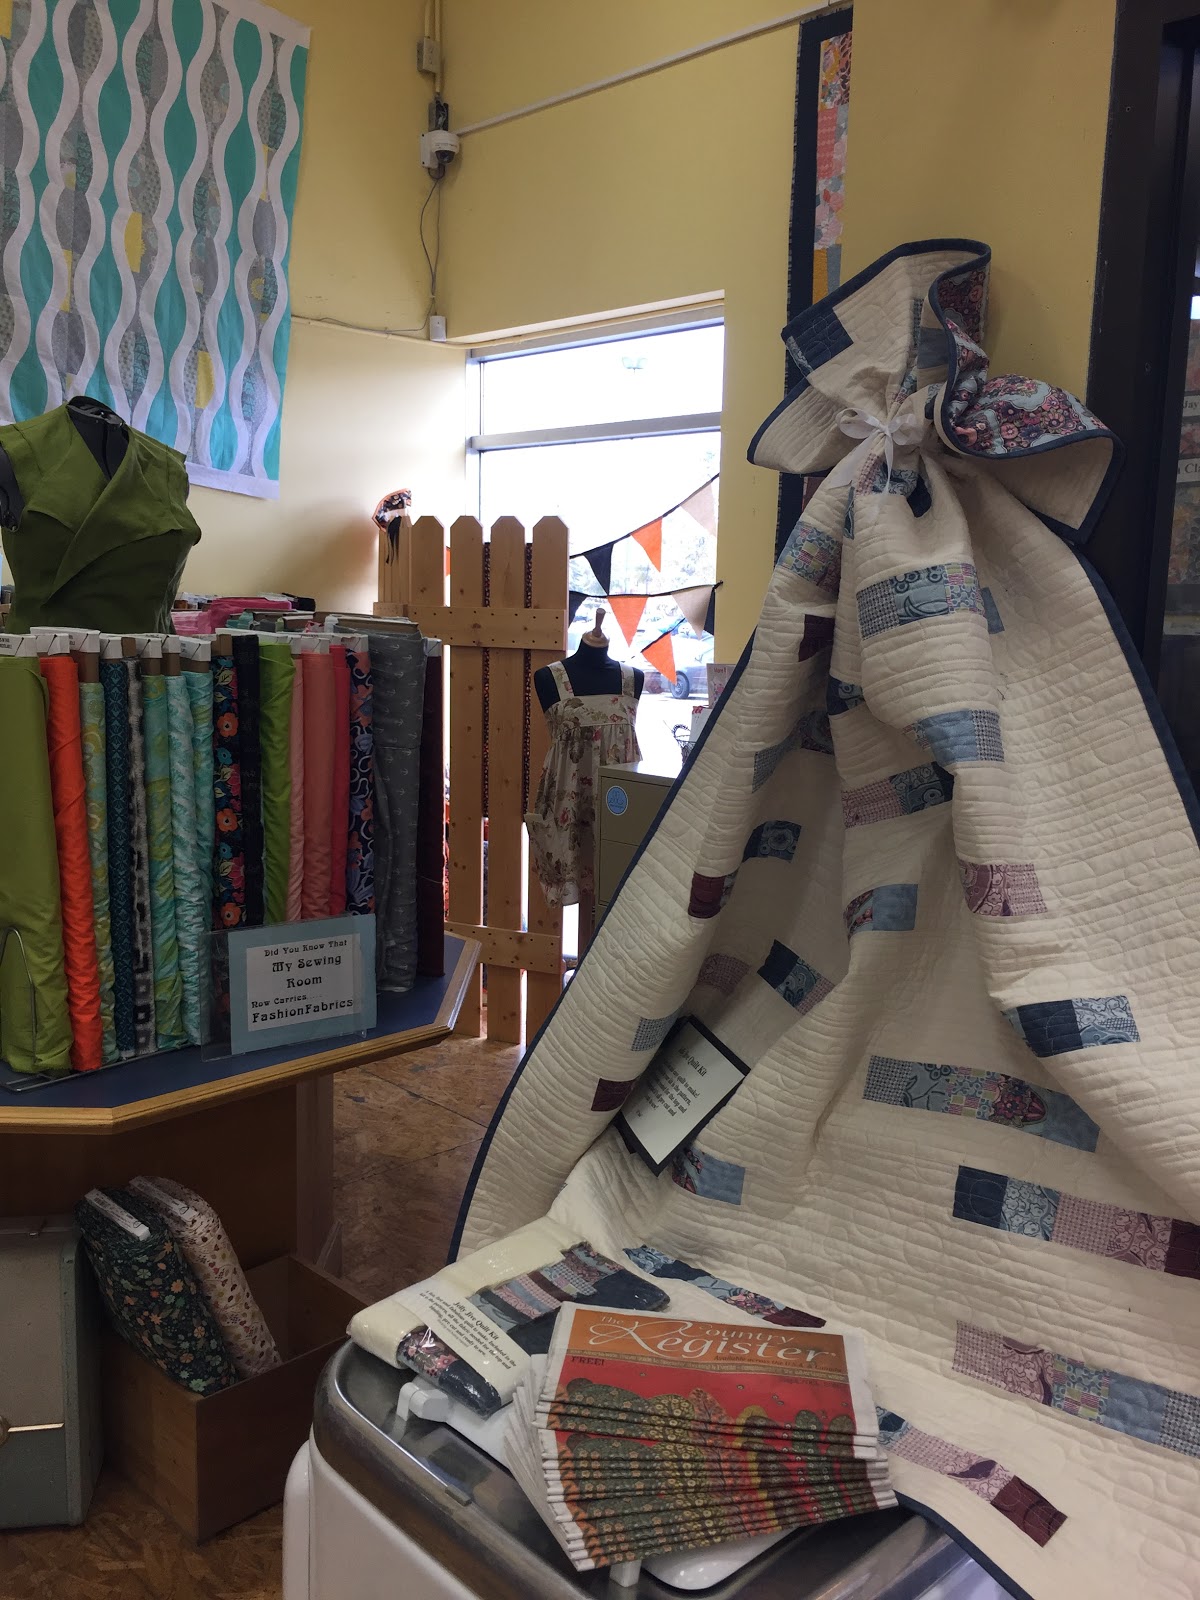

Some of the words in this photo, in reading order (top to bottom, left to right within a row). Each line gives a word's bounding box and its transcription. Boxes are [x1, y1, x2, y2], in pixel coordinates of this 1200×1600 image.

[264, 948, 279, 957] Did
[282, 946, 299, 954] You
[302, 943, 325, 952] Know
[328, 939, 347, 948] That
[272, 961, 292, 973] My
[297, 955, 342, 969] Sewing
[286, 976, 322, 989] Room
[251, 1000, 271, 1009] Now
[687, 1056, 700, 1070] Quilt
[697, 1066, 707, 1077] Kit
[668, 1108, 677, 1116] and
[678, 1105, 687, 1113] and
[453, 1302, 466, 1312] Jelly
[464, 1311, 476, 1321] Jive
[475, 1320, 490, 1332] Quilt
[488, 1331, 499, 1340] Kit
[464, 1320, 474, 1329] quilt
[601, 1315, 624, 1326] The
[698, 1322, 798, 1344] Country
[588, 1320, 828, 1362] Register
[571, 1355, 605, 1366] FREE!
